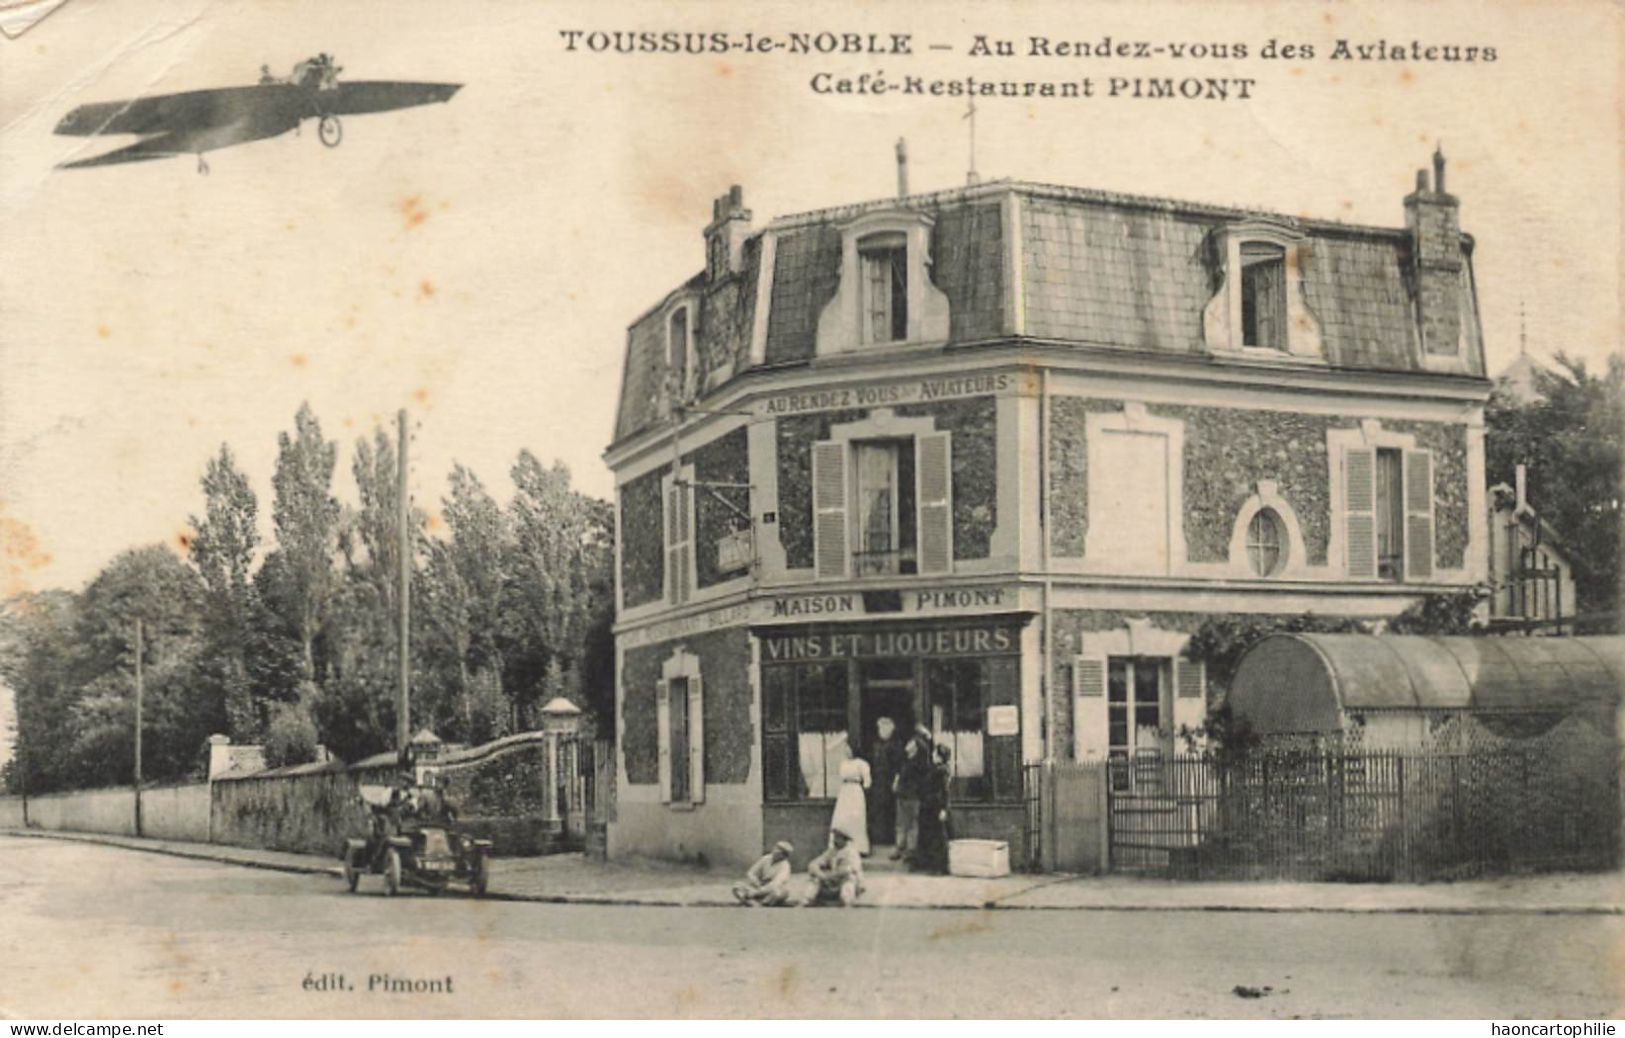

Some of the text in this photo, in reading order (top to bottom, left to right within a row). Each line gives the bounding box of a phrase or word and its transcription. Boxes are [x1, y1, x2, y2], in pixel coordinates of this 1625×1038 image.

[766, 397, 788, 415] AU
[789, 390, 851, 413] RENDEZ
[854, 385, 900, 407] VOUS
[919, 374, 1010, 400] AVIATEURS
[772, 589, 1006, 618] MAISON PIMONT
[766, 627, 1011, 660] VINS ET LIQUEURS
